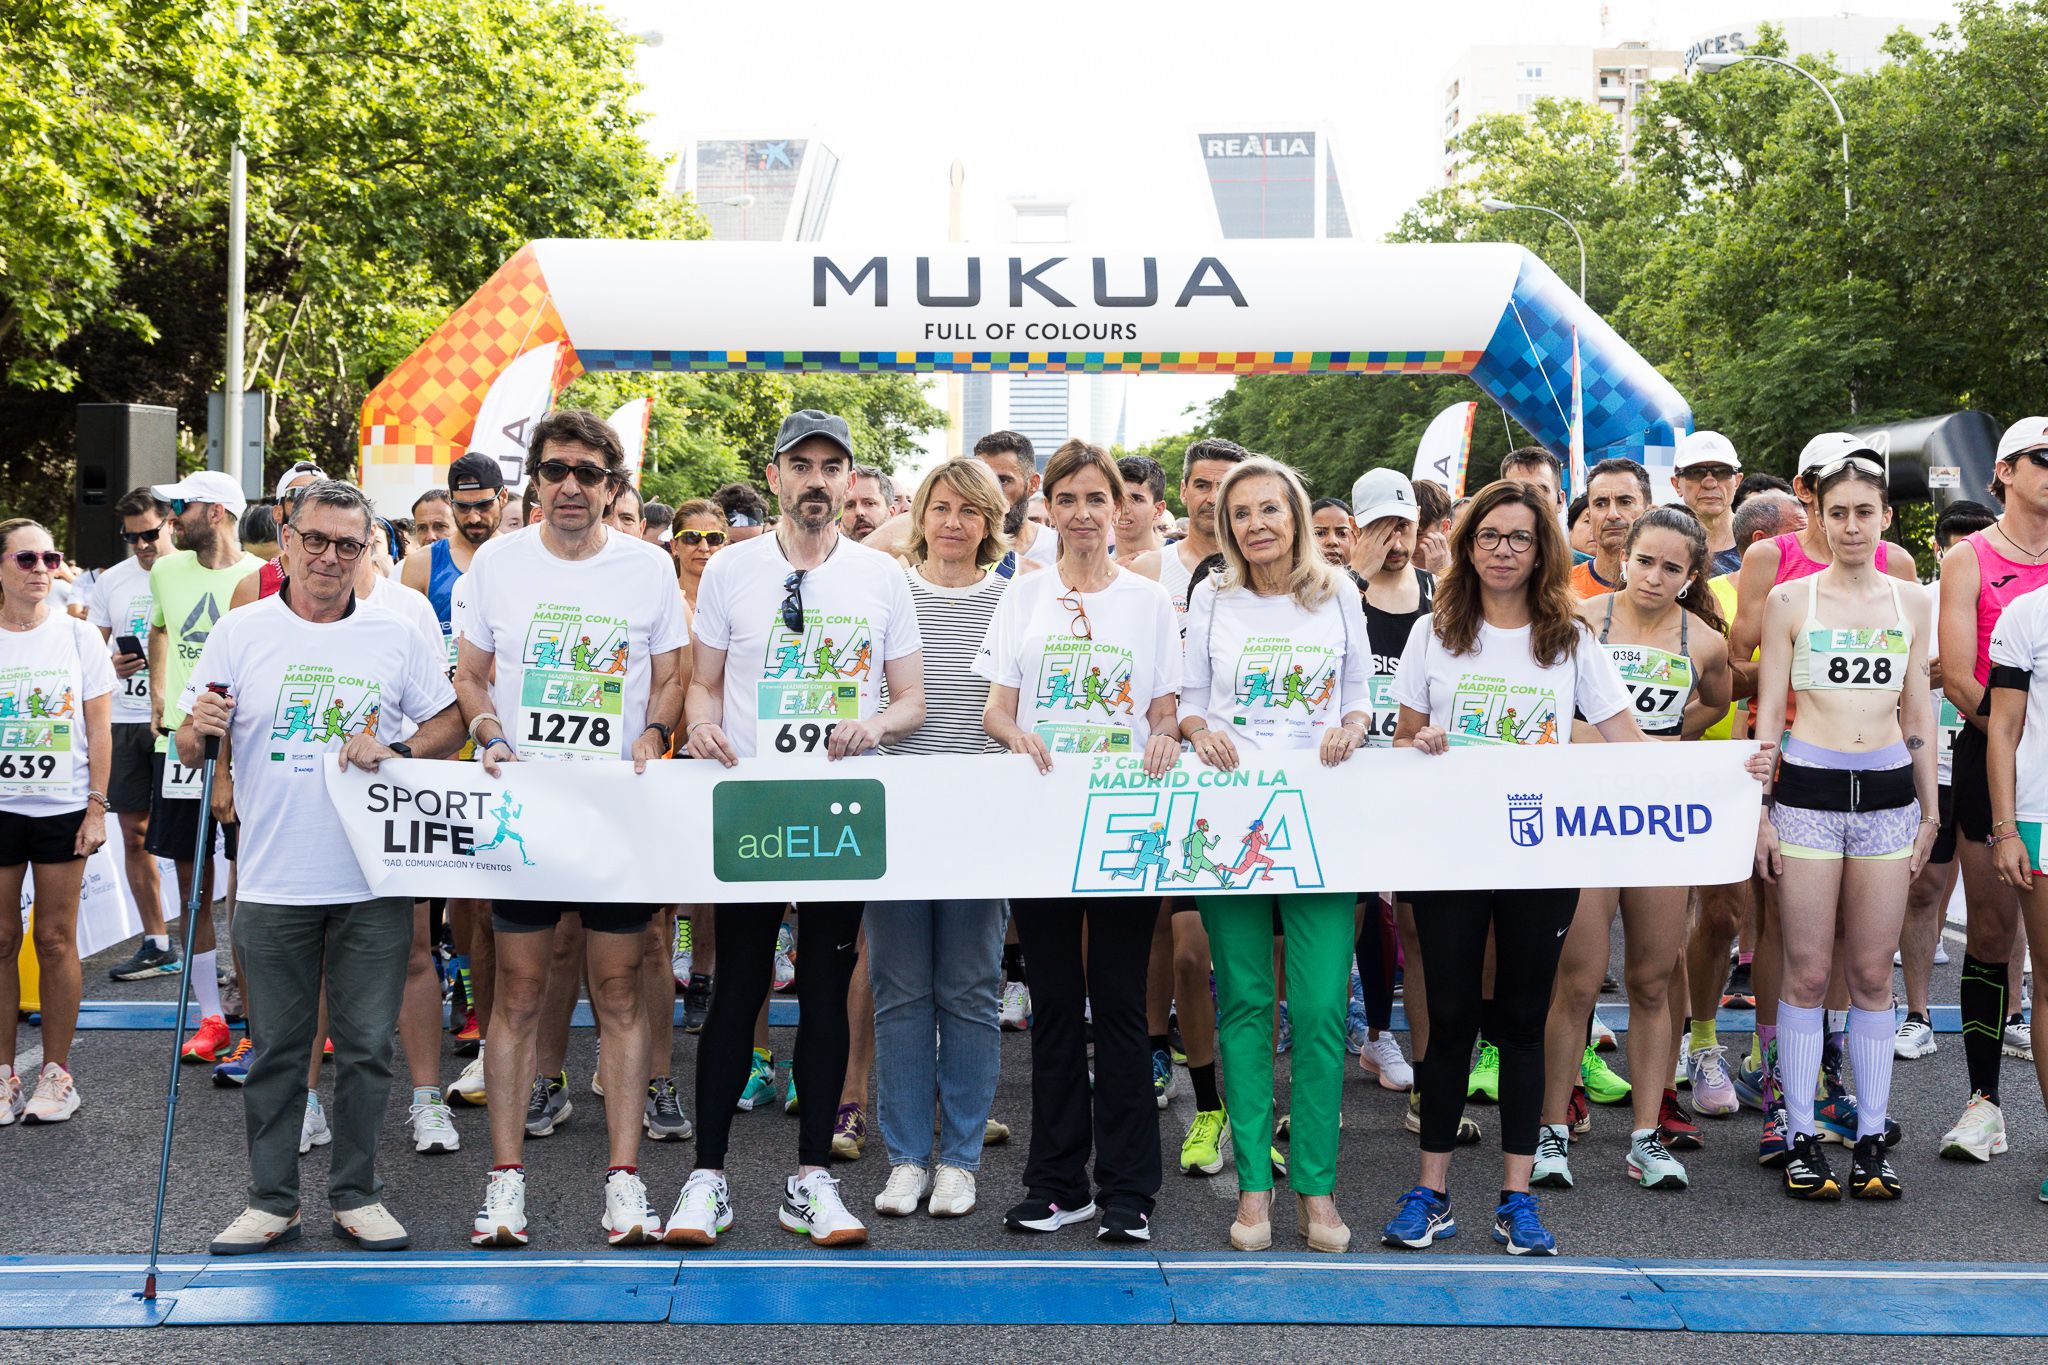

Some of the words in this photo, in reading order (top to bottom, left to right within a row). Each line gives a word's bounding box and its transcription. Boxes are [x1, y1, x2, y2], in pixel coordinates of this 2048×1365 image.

[813, 256, 1249, 308] MUKUA
[924, 322, 977, 340] FULL
[985, 322, 1017, 340] OF
[1025, 322, 1137, 340] COLOURS
[547, 603, 581, 612] Carrera
[533, 612, 583, 623] MADRID
[585, 615, 612, 624] CON
[614, 618, 628, 626] LA
[774, 615, 823, 625] MRID
[826, 616, 851, 624] CON
[855, 617, 869, 625] LA
[1830, 628, 1889, 649] ELA
[1044, 643, 1091, 653] MADRID
[1094, 644, 1119, 654] CON
[1121, 648, 1133, 658] LA
[1243, 644, 1293, 653] MADRID
[1295, 645, 1321, 653] CON
[1323, 647, 1335, 655] LA
[1612, 650, 1641, 662] 0384
[34, 670, 56, 678] CON
[299, 664, 334, 673] Carrera
[1827, 656, 1892, 685] 828
[283, 673, 335, 683] MADRID
[338, 676, 365, 687] CON
[366, 680, 381, 691] LA
[1472, 674, 1506, 683] Carrera
[541, 679, 602, 709] ELA
[1457, 682, 1508, 693] MADRID
[1510, 685, 1538, 695] CON
[1540, 688, 1555, 697] LA
[778, 689, 838, 715] ELA
[1, 727, 54, 749] ELA
[527, 711, 611, 748] 1278
[0, 754, 56, 779] 639
[1091, 755, 1111, 770] 3ª
[1197, 769, 1250, 788] CON
[1257, 769, 1288, 787] LA
[366, 783, 492, 820] SPORT
[1555, 803, 1713, 843] MADRID
[383, 819, 476, 857] LIFE
[737, 824, 862, 859] adELA
[1071, 789, 1326, 893] ELA
[405, 858, 468, 869] COMUNICACIÓN
[469, 861, 475, 869] Y
[476, 861, 512, 872] EVENTOS
